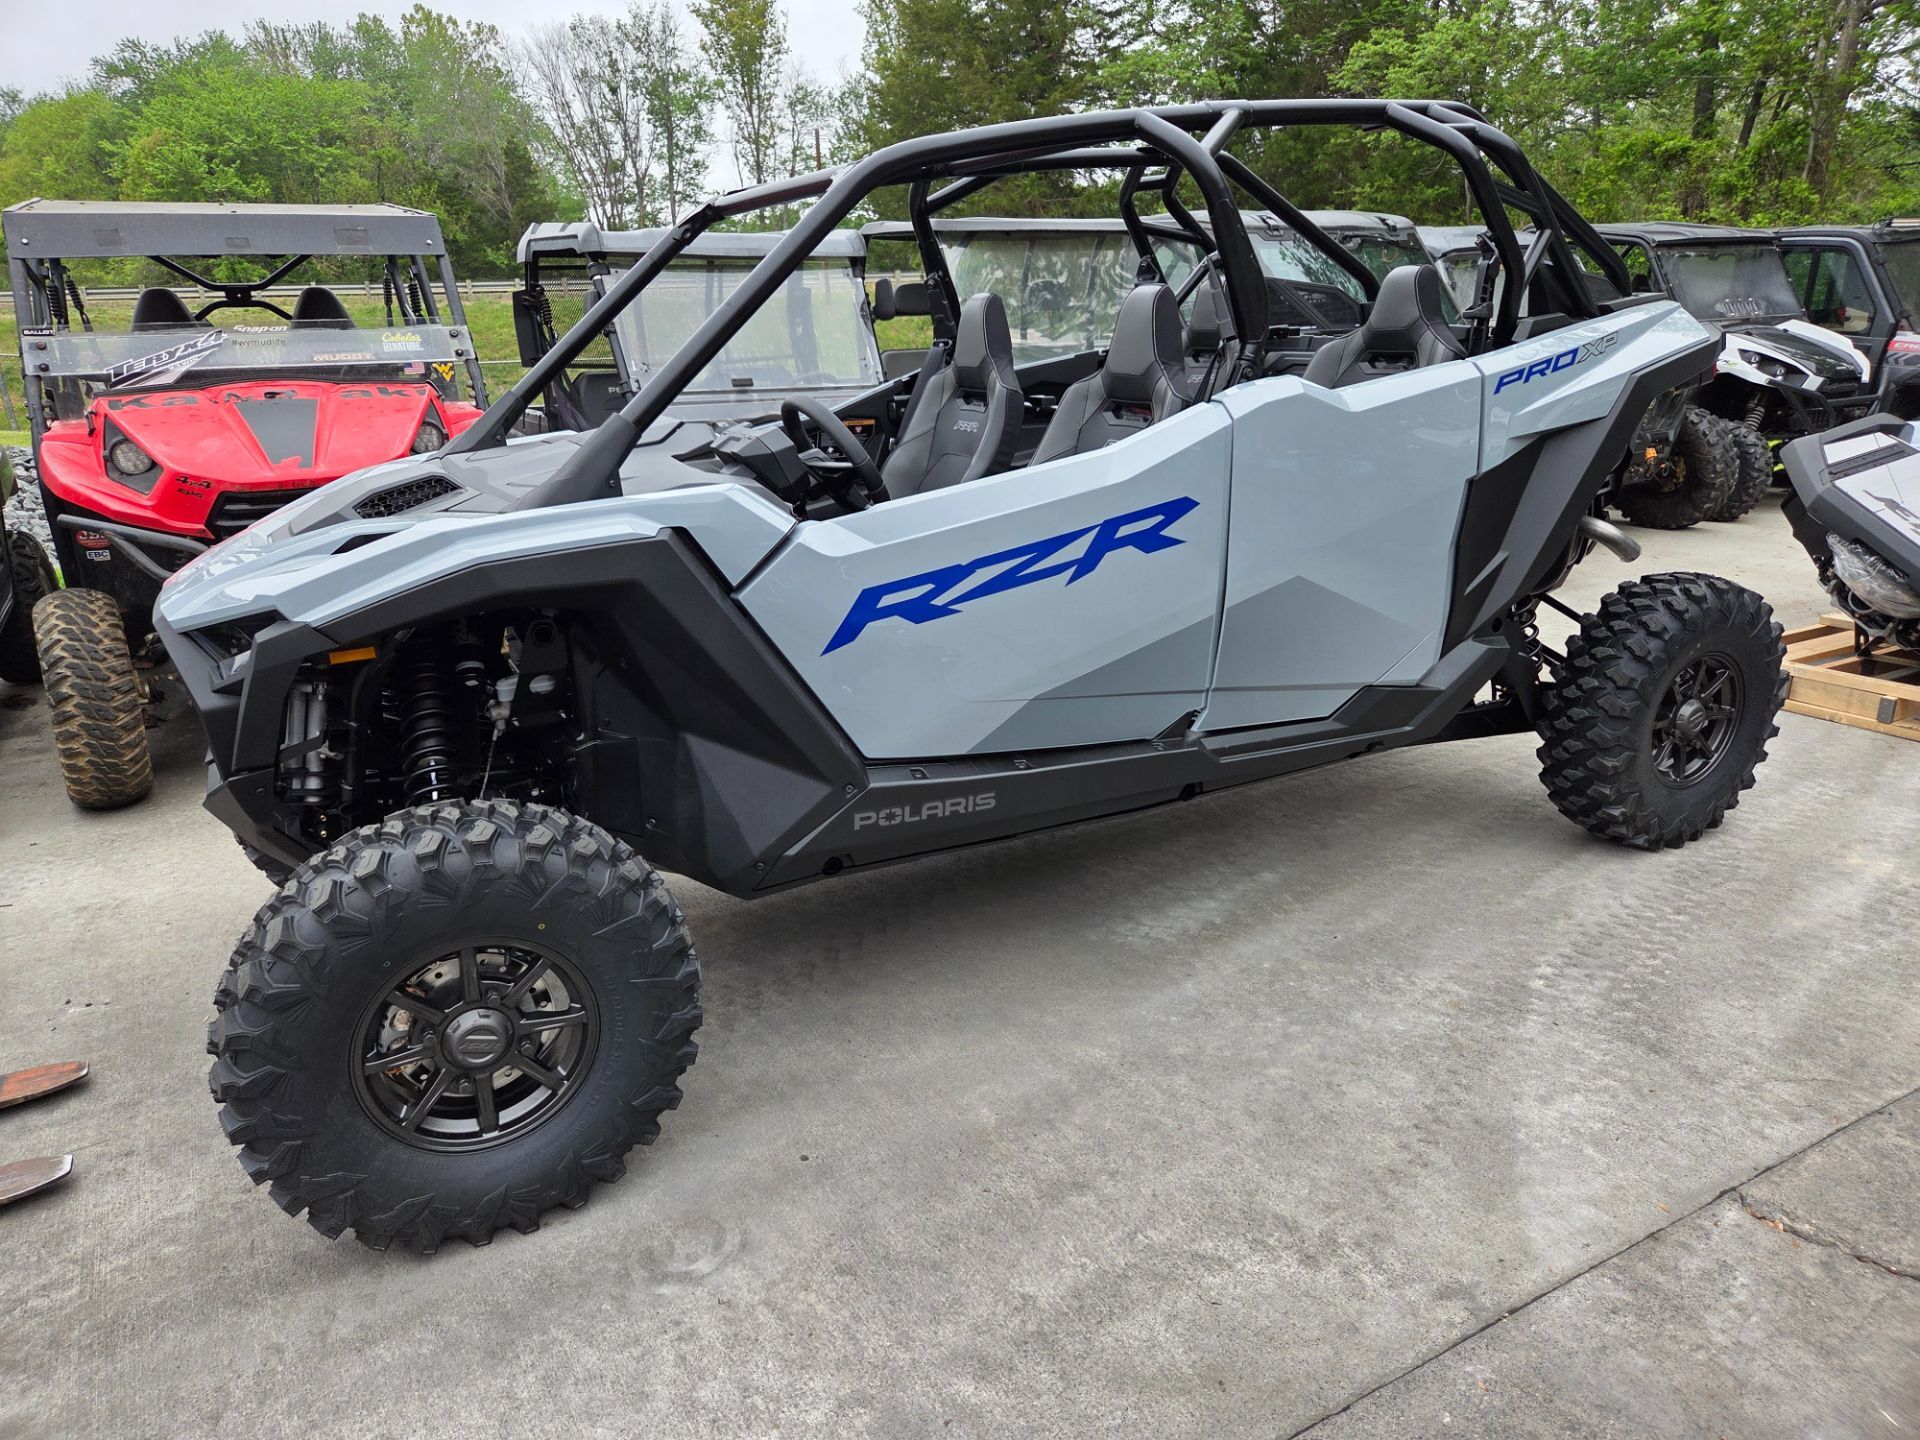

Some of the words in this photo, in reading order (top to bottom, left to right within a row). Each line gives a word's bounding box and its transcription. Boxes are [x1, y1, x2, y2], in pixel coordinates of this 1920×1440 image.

[1493, 346, 1580, 395] PRO
[1576, 330, 1619, 365] XP
[820, 496, 1200, 657] RZR
[854, 792, 996, 831] POLARIS
